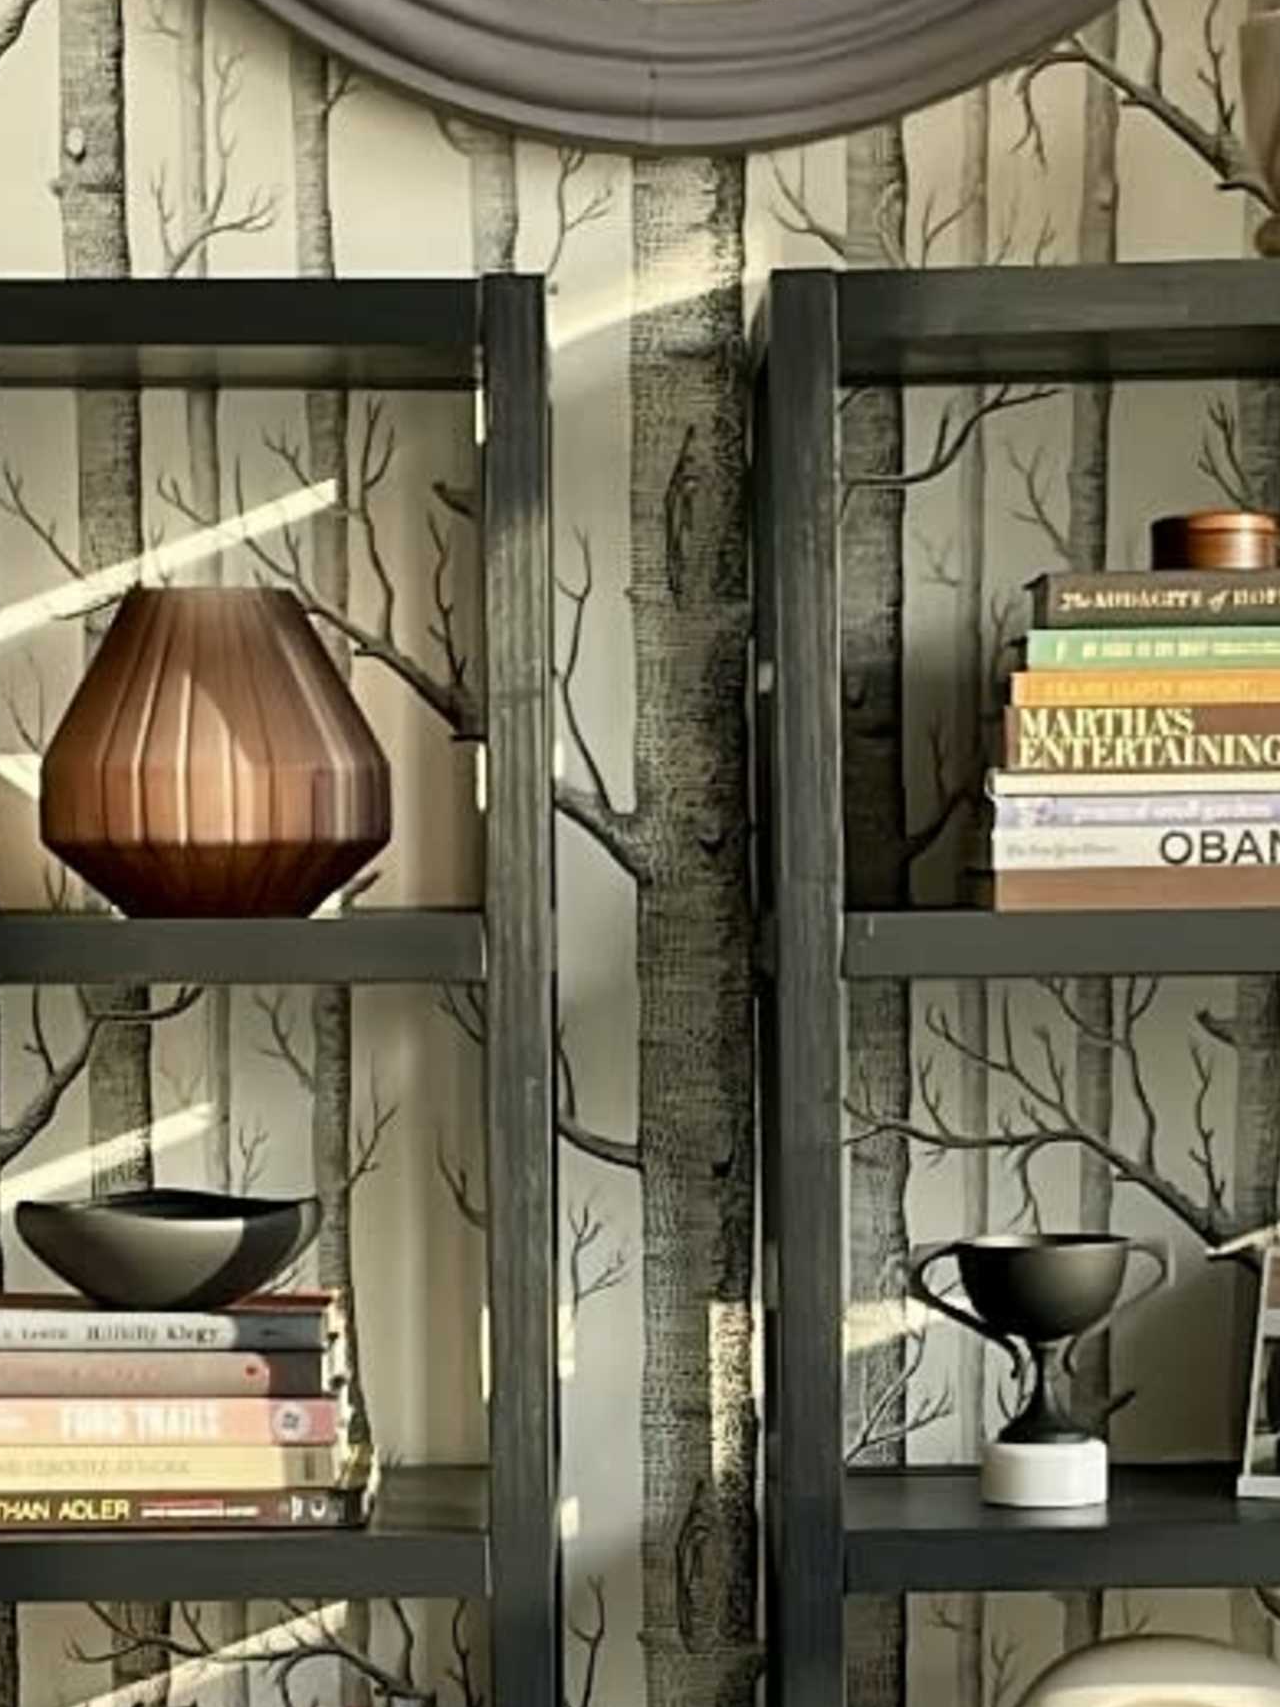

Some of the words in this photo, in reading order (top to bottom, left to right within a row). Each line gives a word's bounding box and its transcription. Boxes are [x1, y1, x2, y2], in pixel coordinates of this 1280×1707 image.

[1091, 588, 1203, 611] AUDACITY
[1207, 588, 1229, 614] of
[1020, 707, 1194, 739] MARTHA'S
[58, 1496, 131, 1520] ADLER
